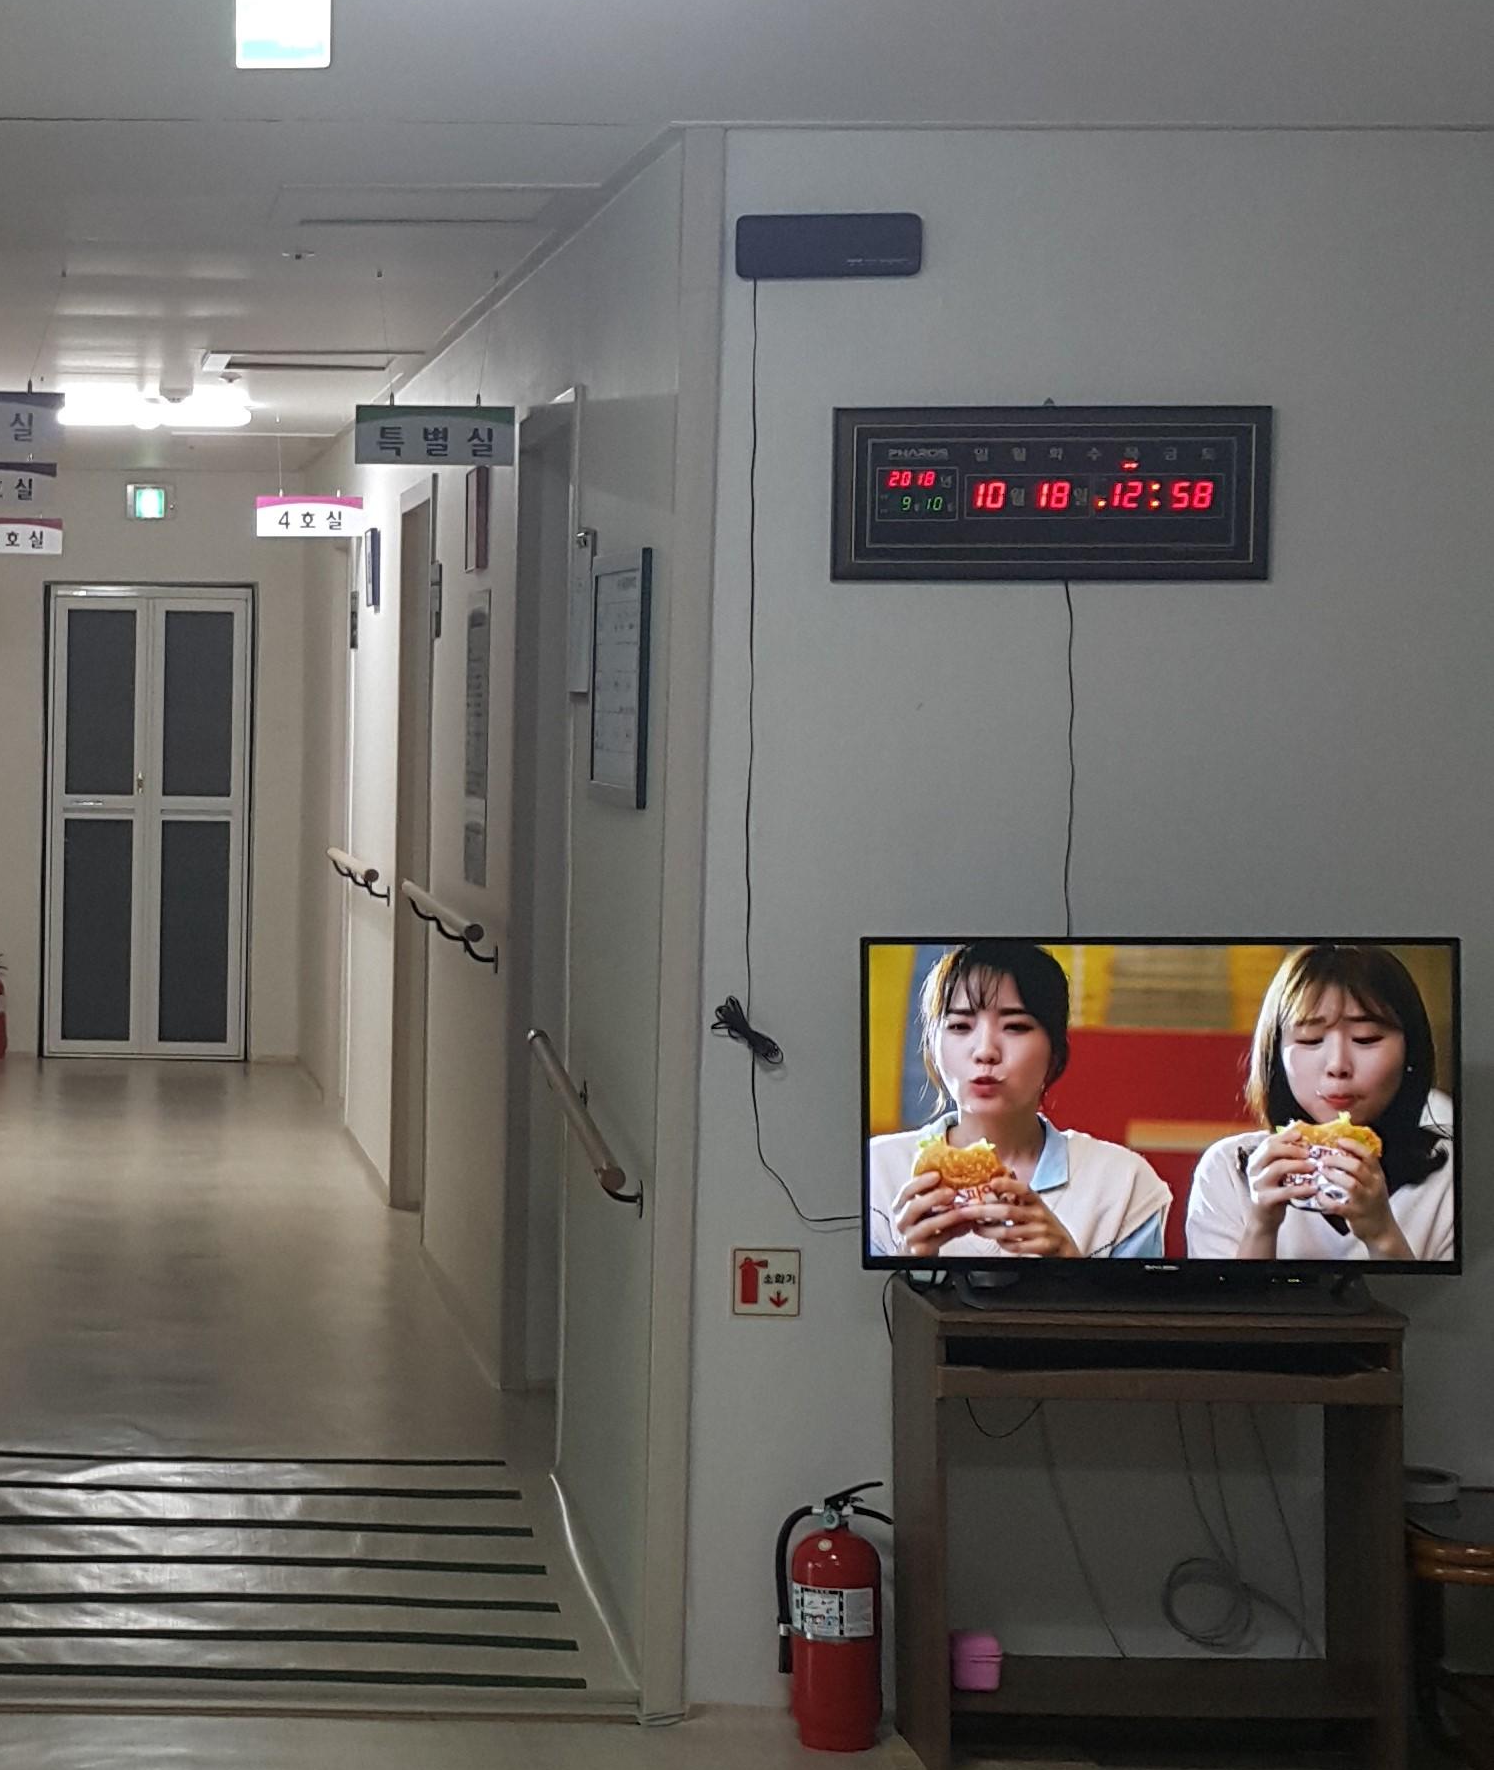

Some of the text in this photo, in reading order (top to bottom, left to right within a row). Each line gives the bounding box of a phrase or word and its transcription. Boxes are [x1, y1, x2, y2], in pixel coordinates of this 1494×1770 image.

[376, 426, 495, 457] 특별실
[888, 470, 936, 487] 2018
[901, 495, 912, 511] 9
[926, 495, 944, 511] 10
[975, 481, 1006, 508] 10
[1039, 481, 1071, 508] 18
[1110, 481, 1215, 509] 12:58
[277, 510, 343, 531] 4호실
[763, 1273, 796, 1285] 소화기
